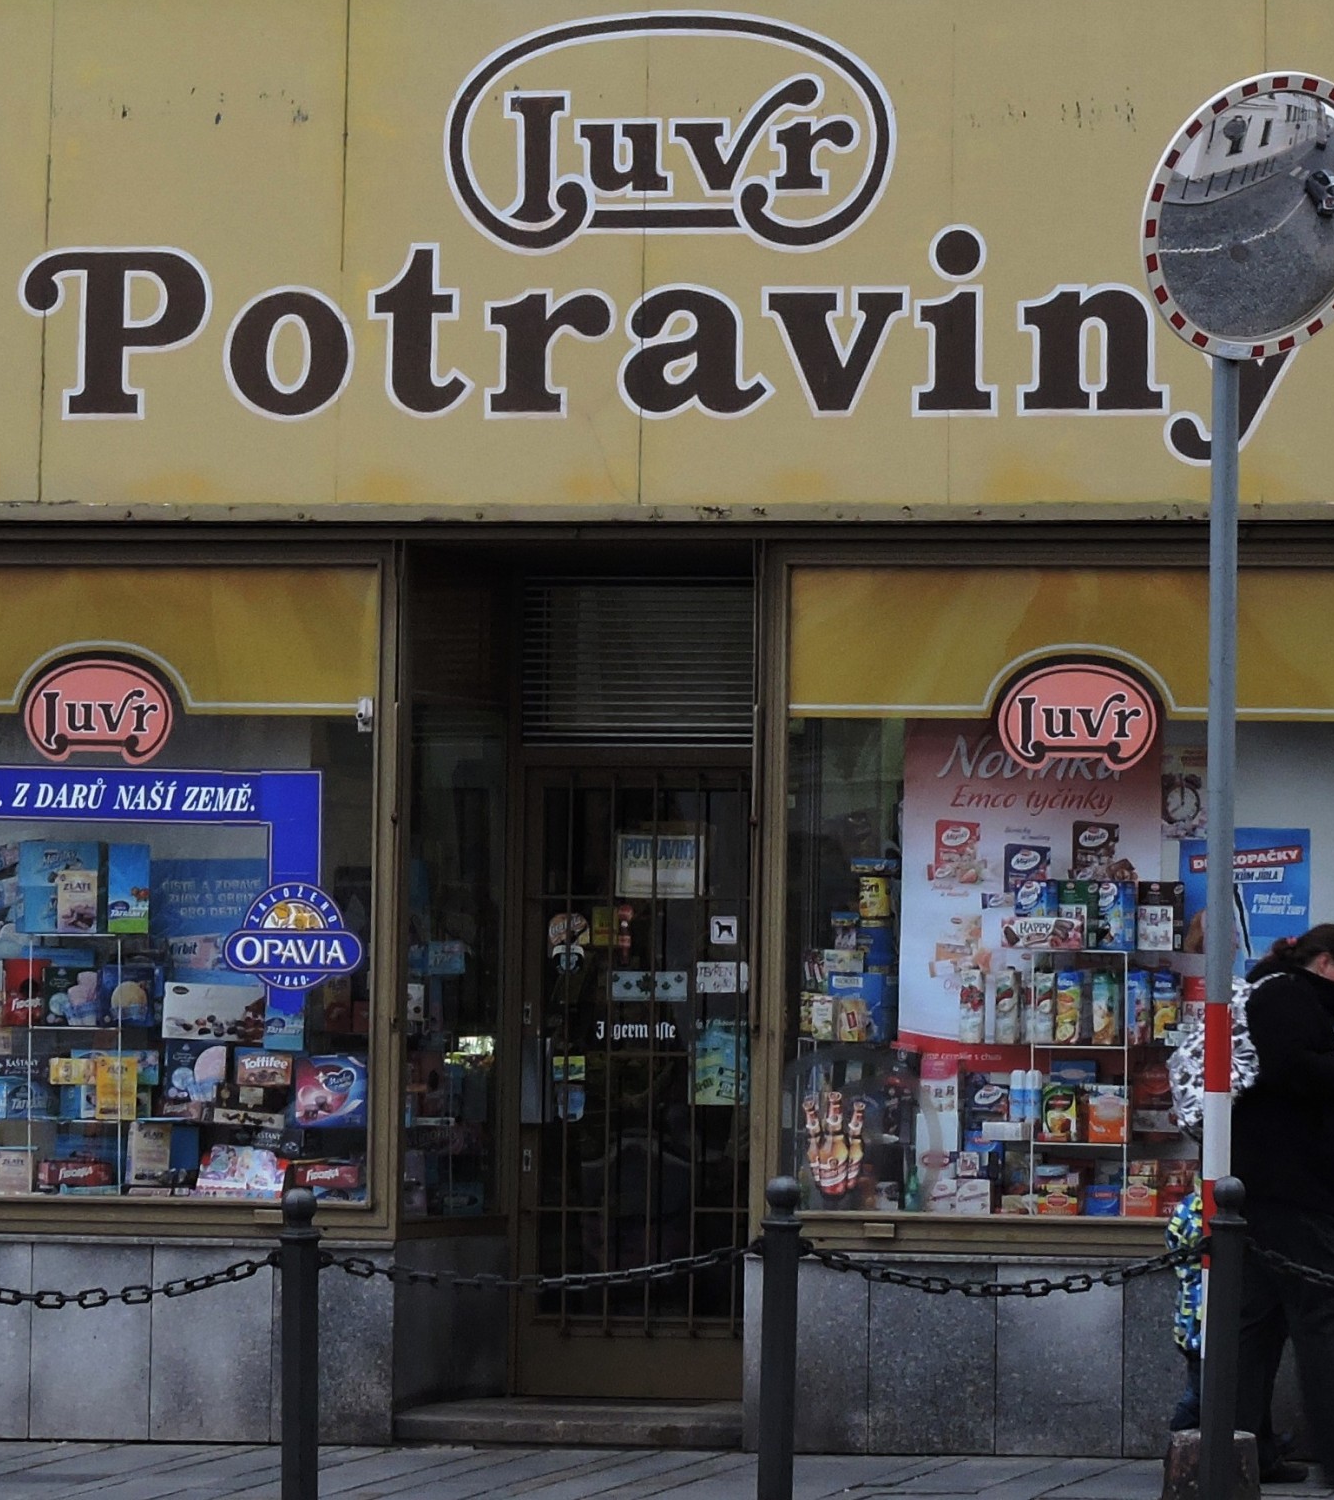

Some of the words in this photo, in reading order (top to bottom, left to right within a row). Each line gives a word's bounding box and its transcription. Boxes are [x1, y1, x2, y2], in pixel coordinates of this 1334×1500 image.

[504, 73, 860, 230] Juvr
[42, 688, 160, 749] Juvr
[1017, 692, 1142, 755] Juvr
[12, 783, 29, 807] Z
[34, 777, 107, 809] DARŮ
[113, 781, 178, 811] NAŠÍ
[181, 783, 256, 812] ZEMĚ.
[951, 784, 1017, 808] Emco
[1027, 785, 1115, 816] tyčinky
[250, 885, 338, 923] ZALOŽENO
[235, 936, 347, 966] OPAVIA
[276, 975, 307, 987] 1840
[241, 1056, 288, 1070] Toffifee
